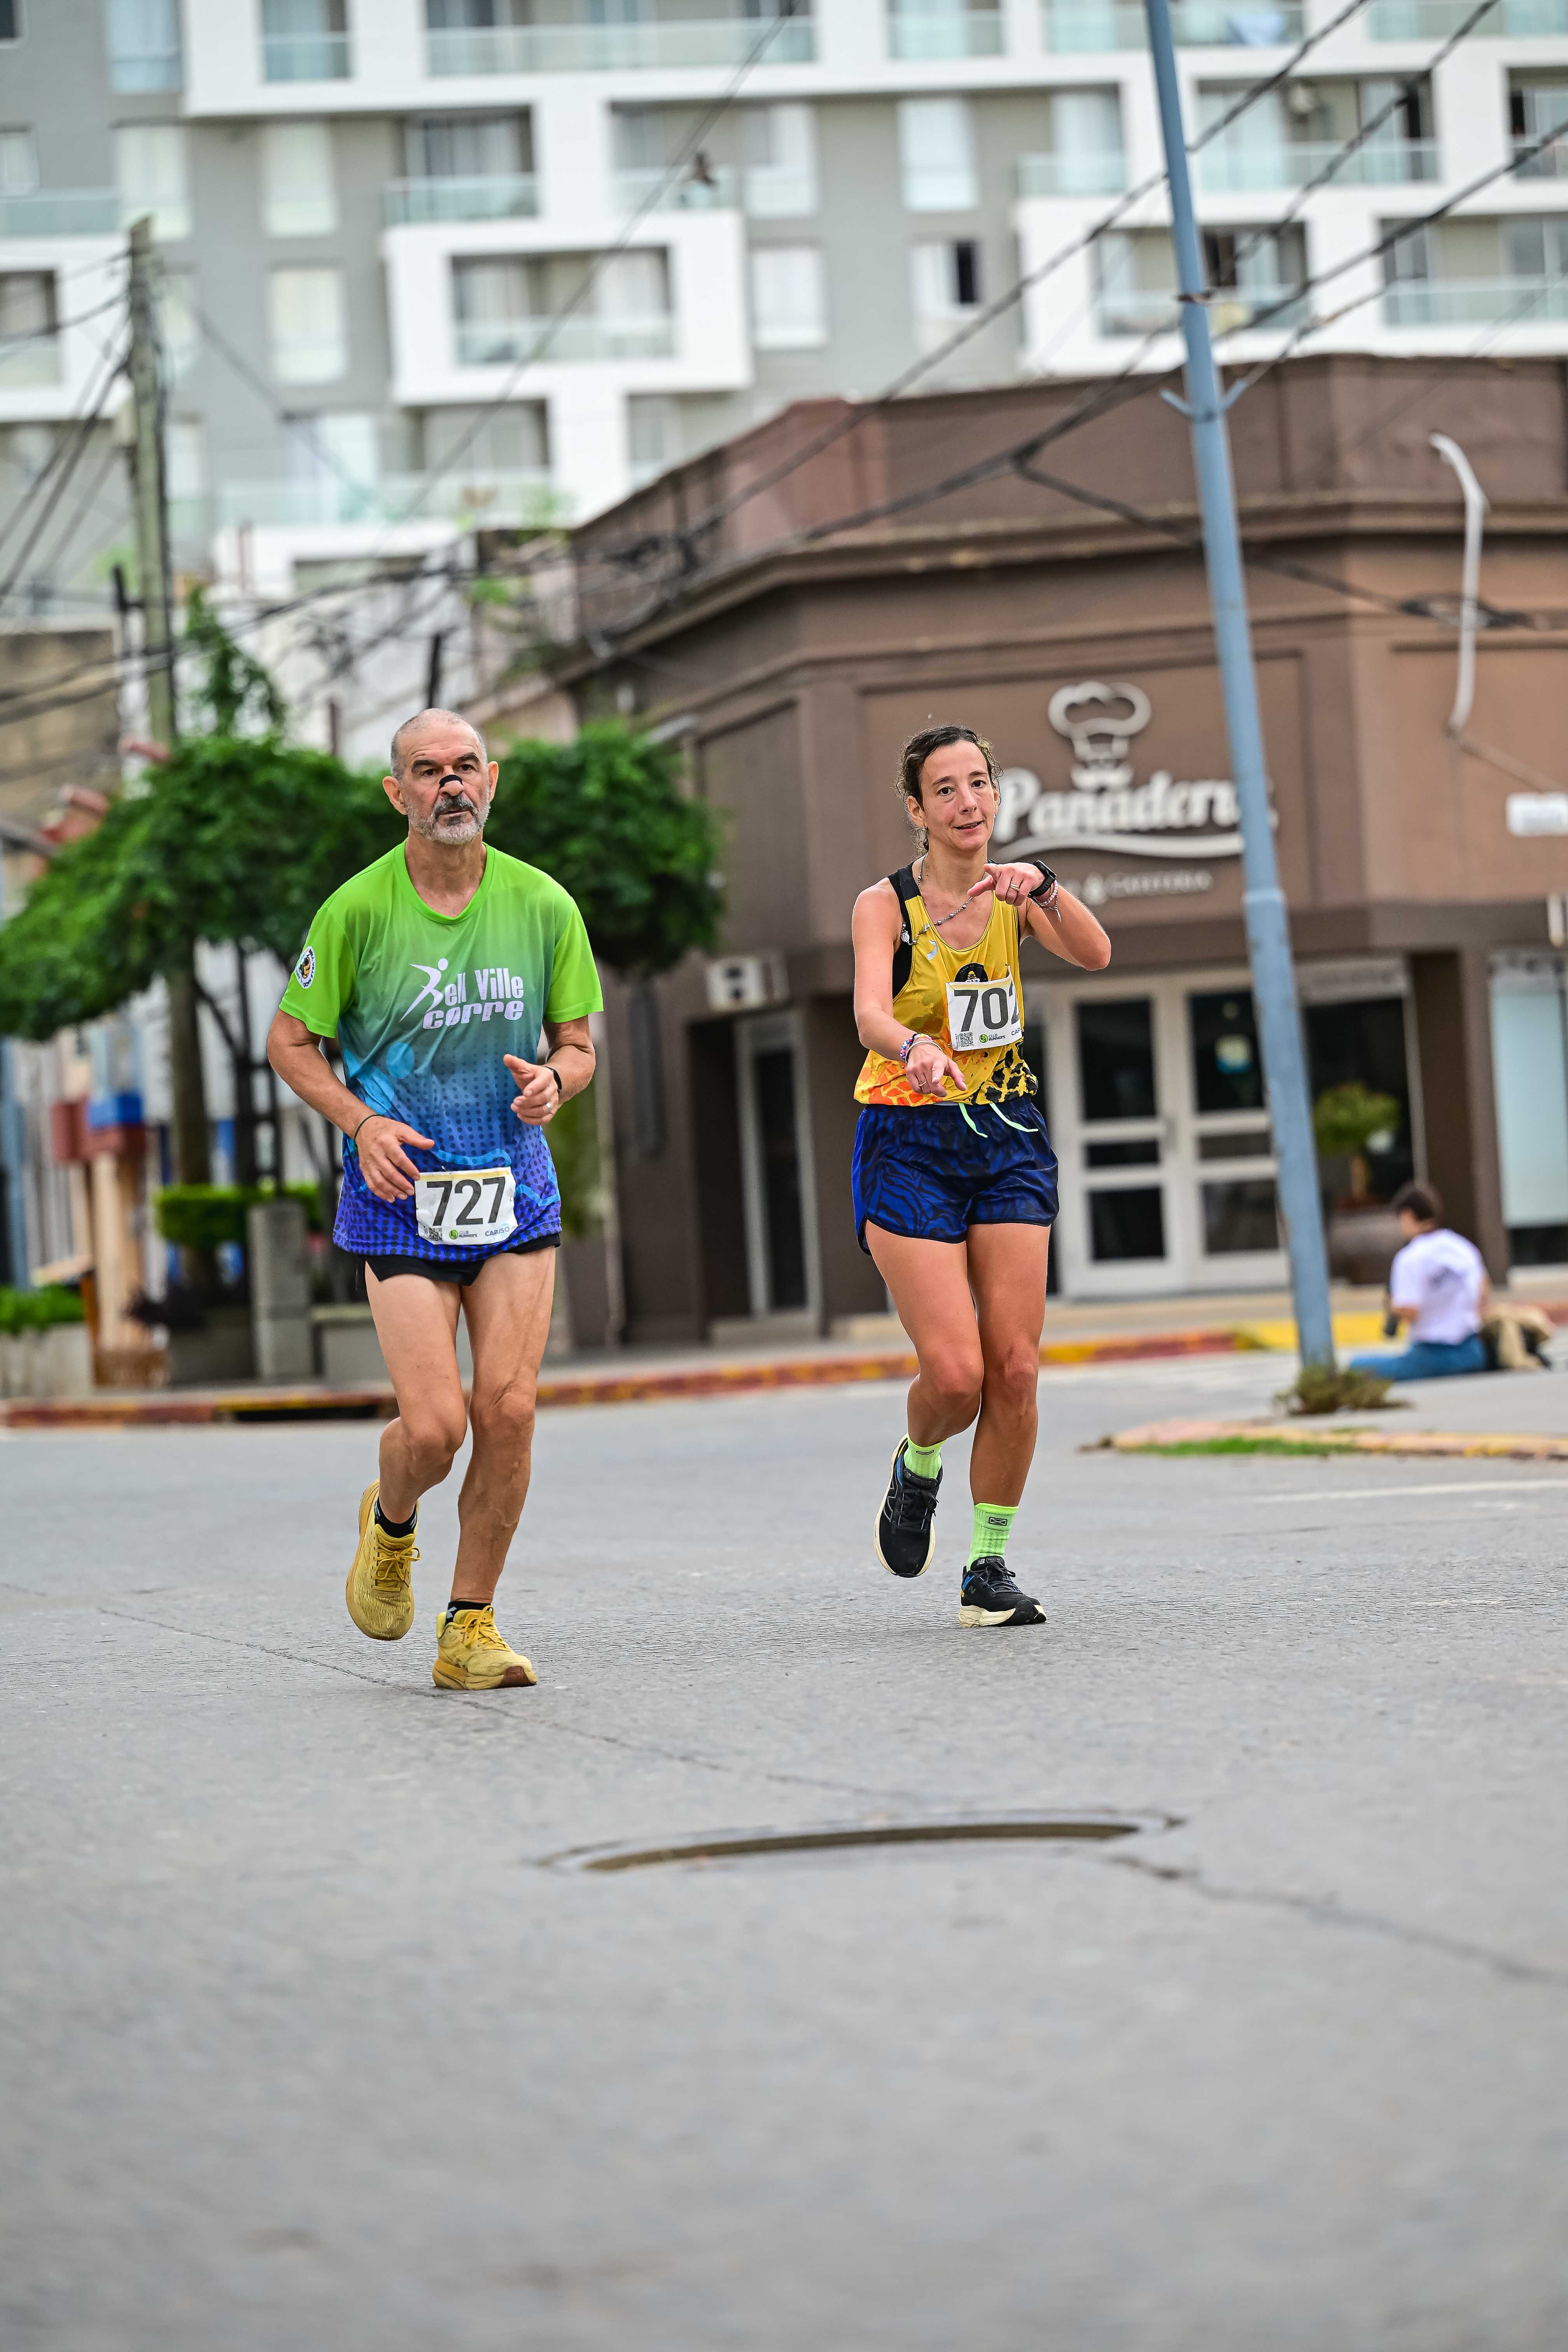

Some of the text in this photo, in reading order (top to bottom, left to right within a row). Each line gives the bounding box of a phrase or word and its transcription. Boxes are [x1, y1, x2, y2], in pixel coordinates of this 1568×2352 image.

[474, 968, 523, 1000] Ville
[427, 1176, 506, 1226] 727
[485, 1227, 510, 1237] CARUSO
